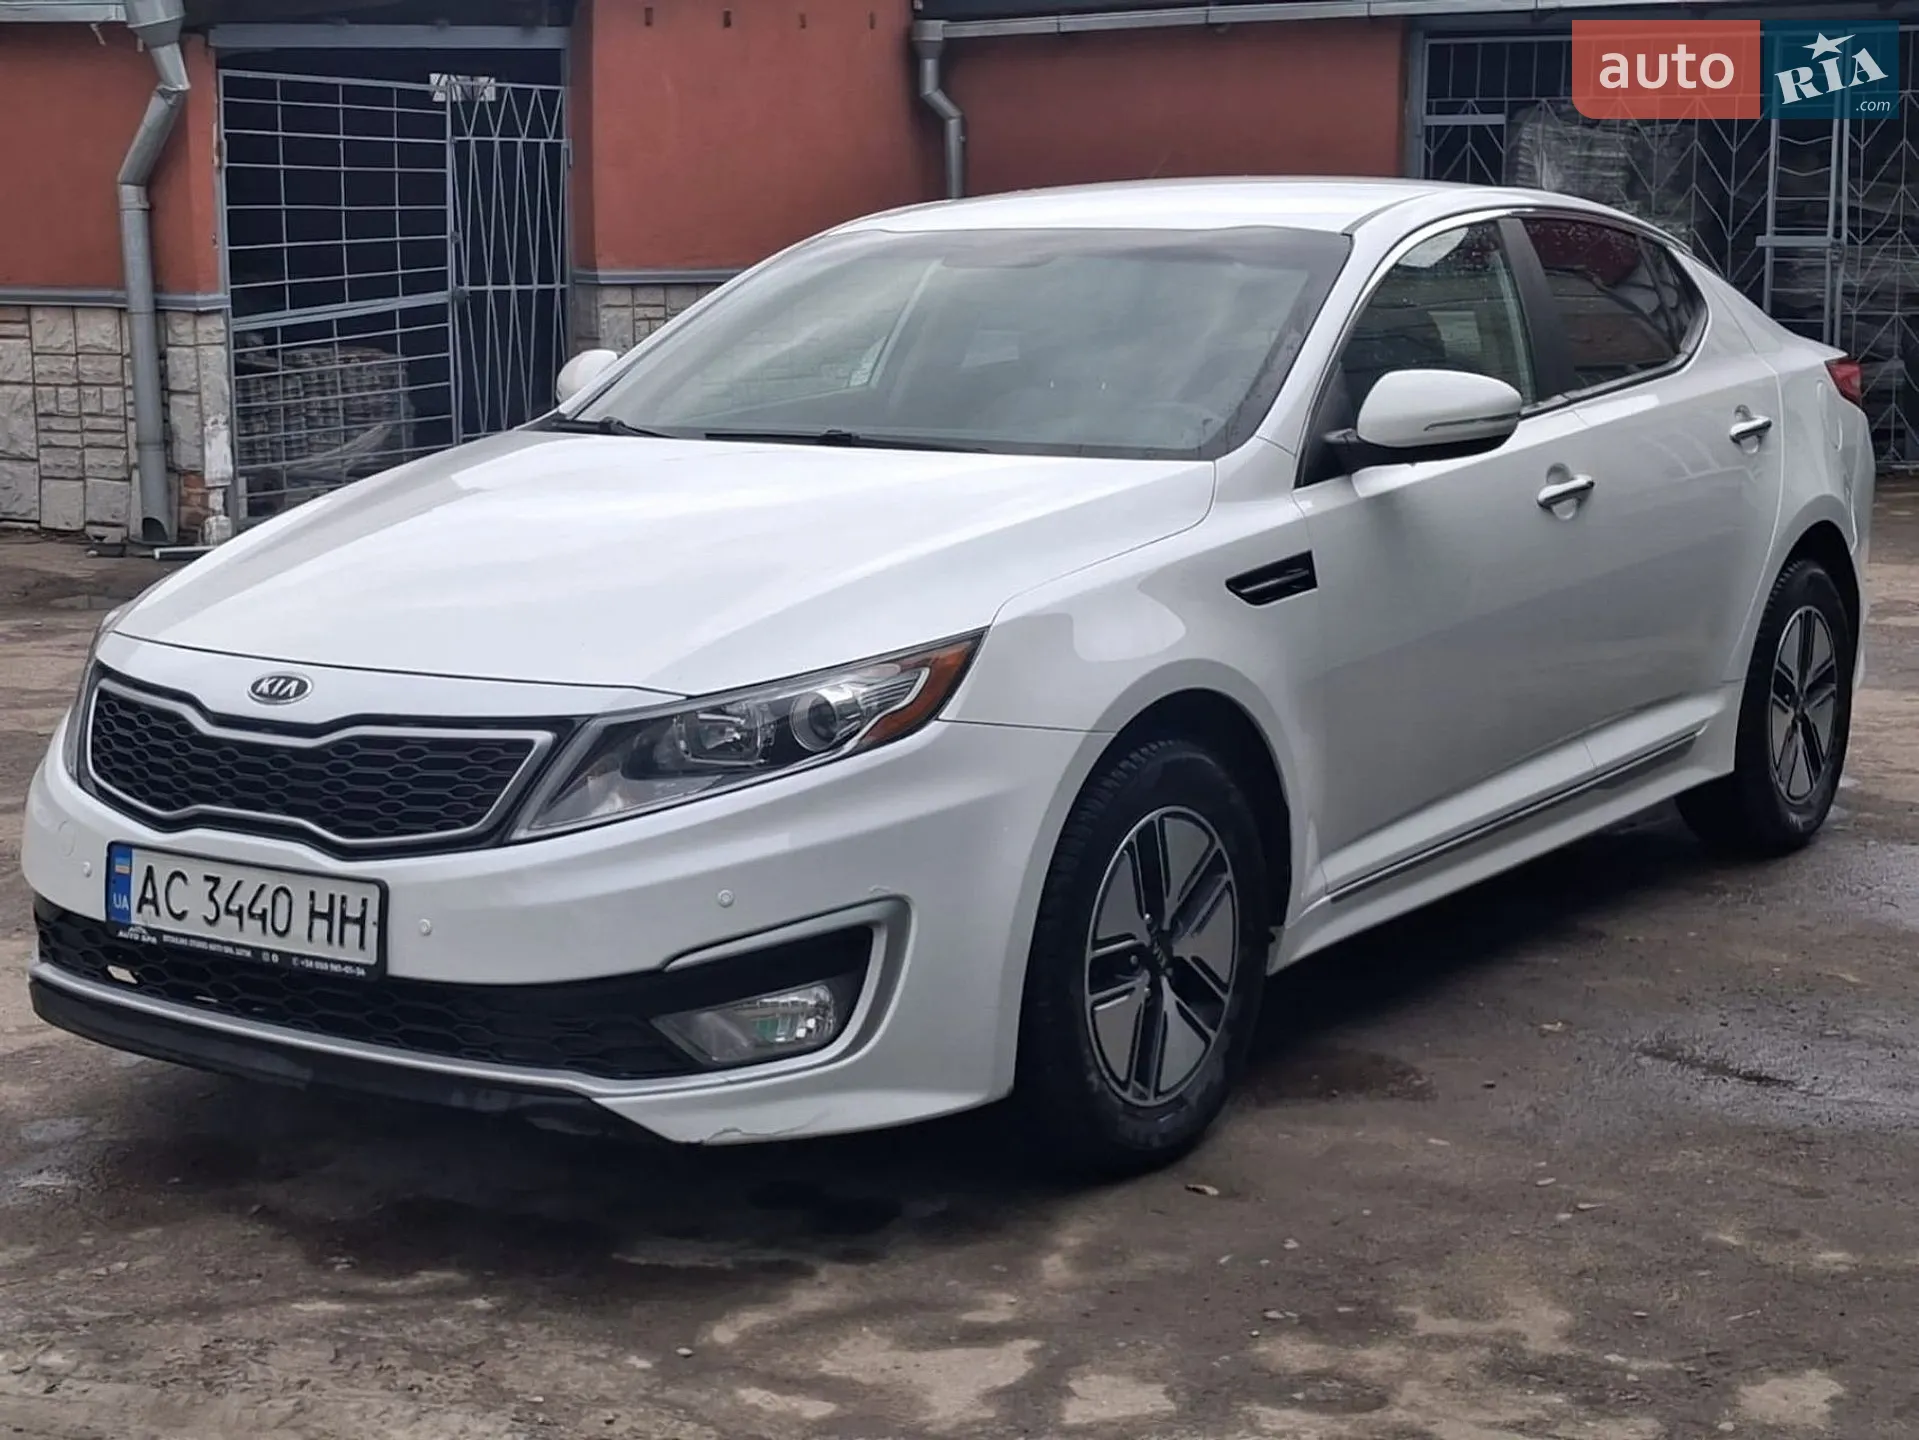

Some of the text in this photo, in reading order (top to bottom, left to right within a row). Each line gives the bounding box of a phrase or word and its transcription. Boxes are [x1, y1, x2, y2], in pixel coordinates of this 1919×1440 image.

[255, 678, 299, 697] KIA
[113, 893, 130, 911] UA
[136, 865, 368, 950] AC 3440 HH
